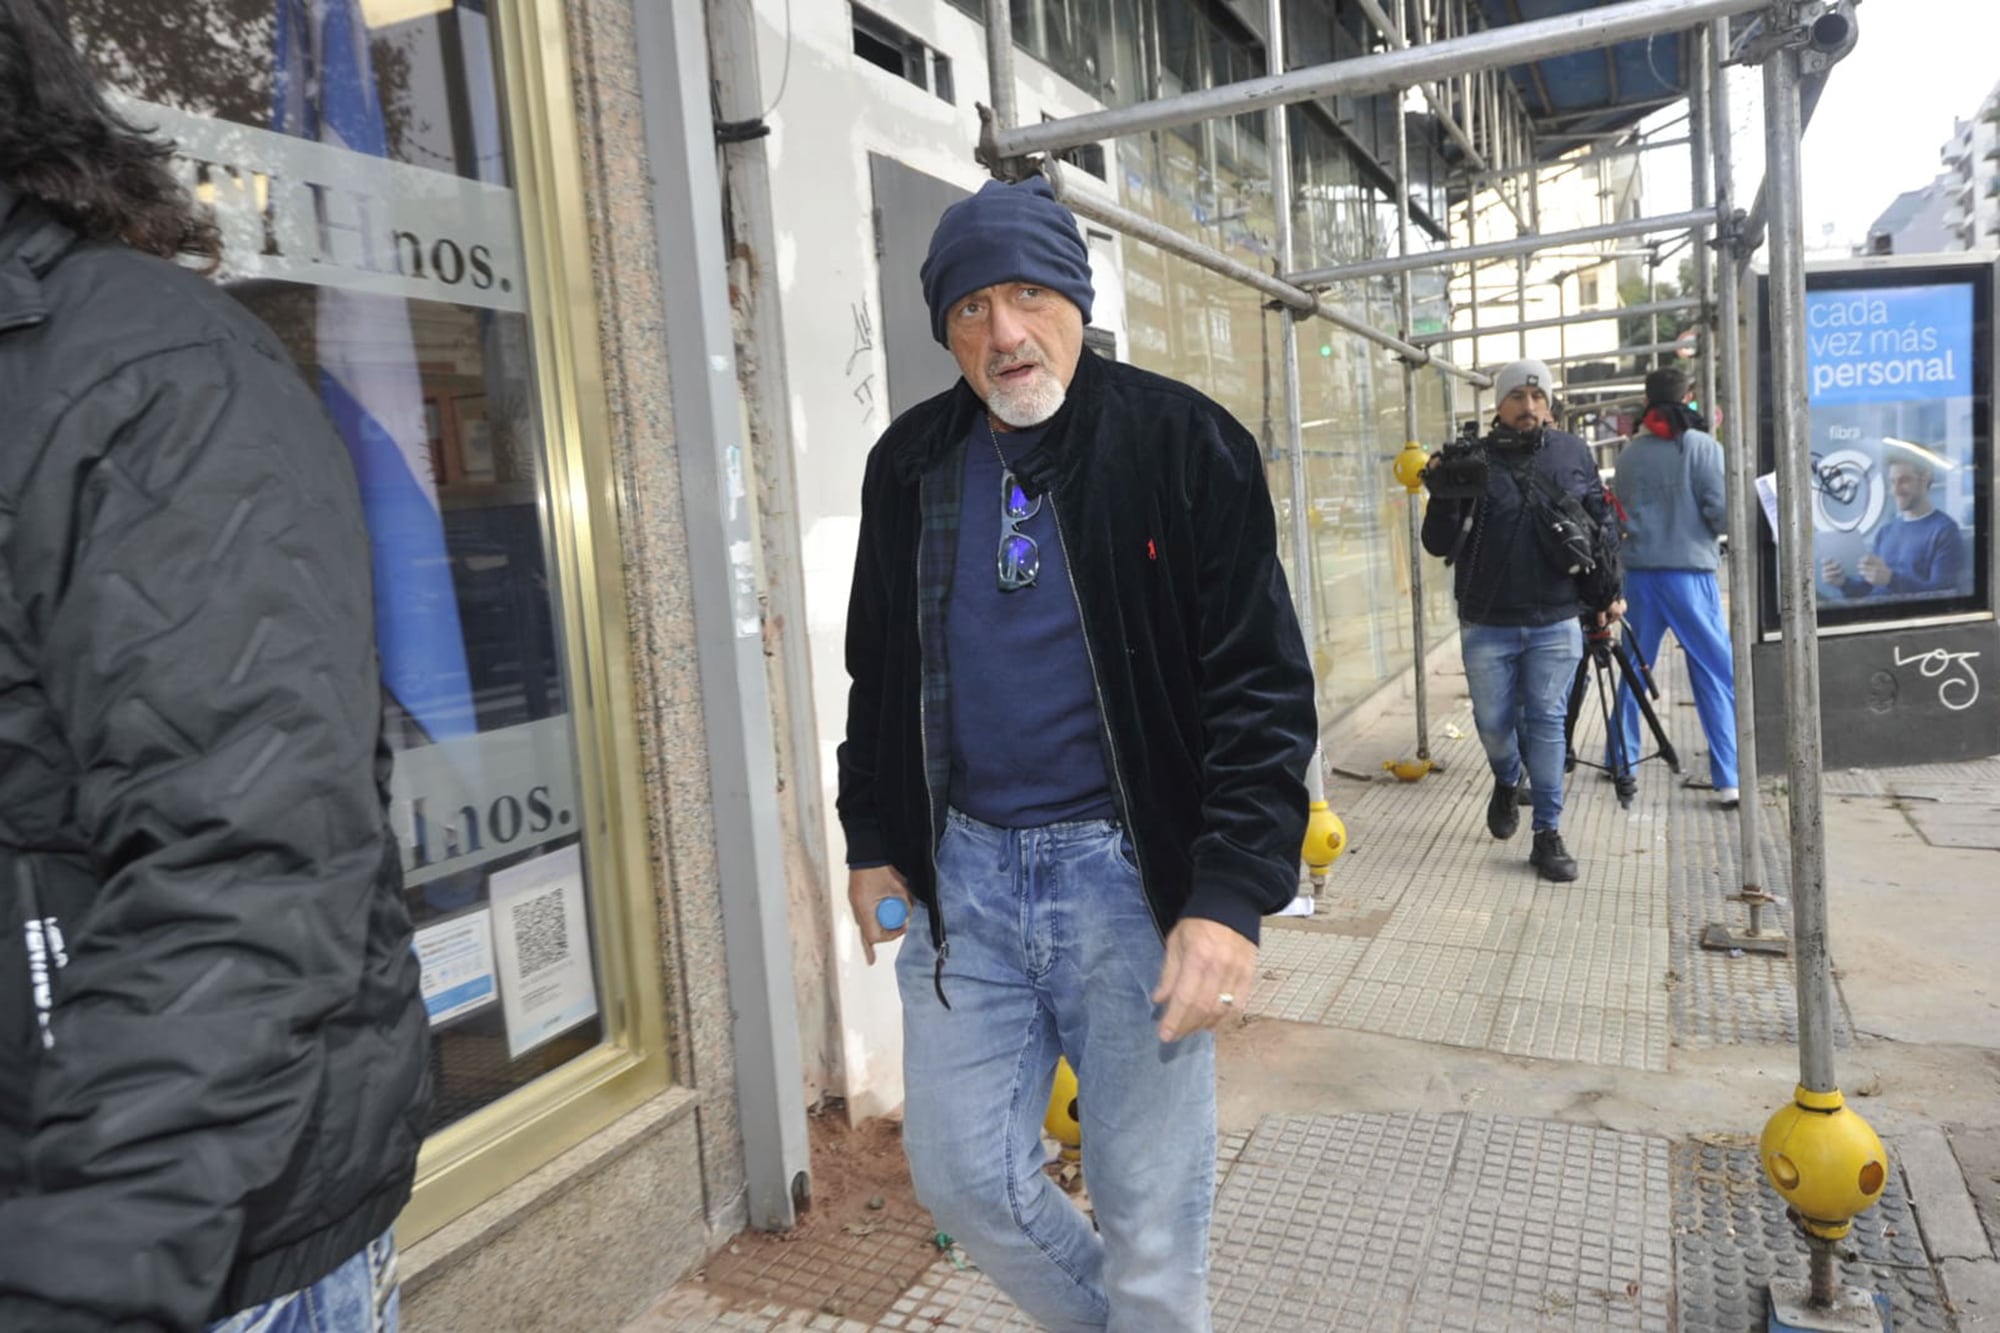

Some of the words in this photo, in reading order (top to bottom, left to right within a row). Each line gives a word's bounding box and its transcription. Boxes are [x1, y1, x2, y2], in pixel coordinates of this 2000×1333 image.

[1810, 295, 1888, 327] cada
[1812, 332, 1863, 357] vez
[1871, 321, 1937, 353] más
[1814, 350, 1955, 395] personal
[1829, 425, 1861, 440] fibra
